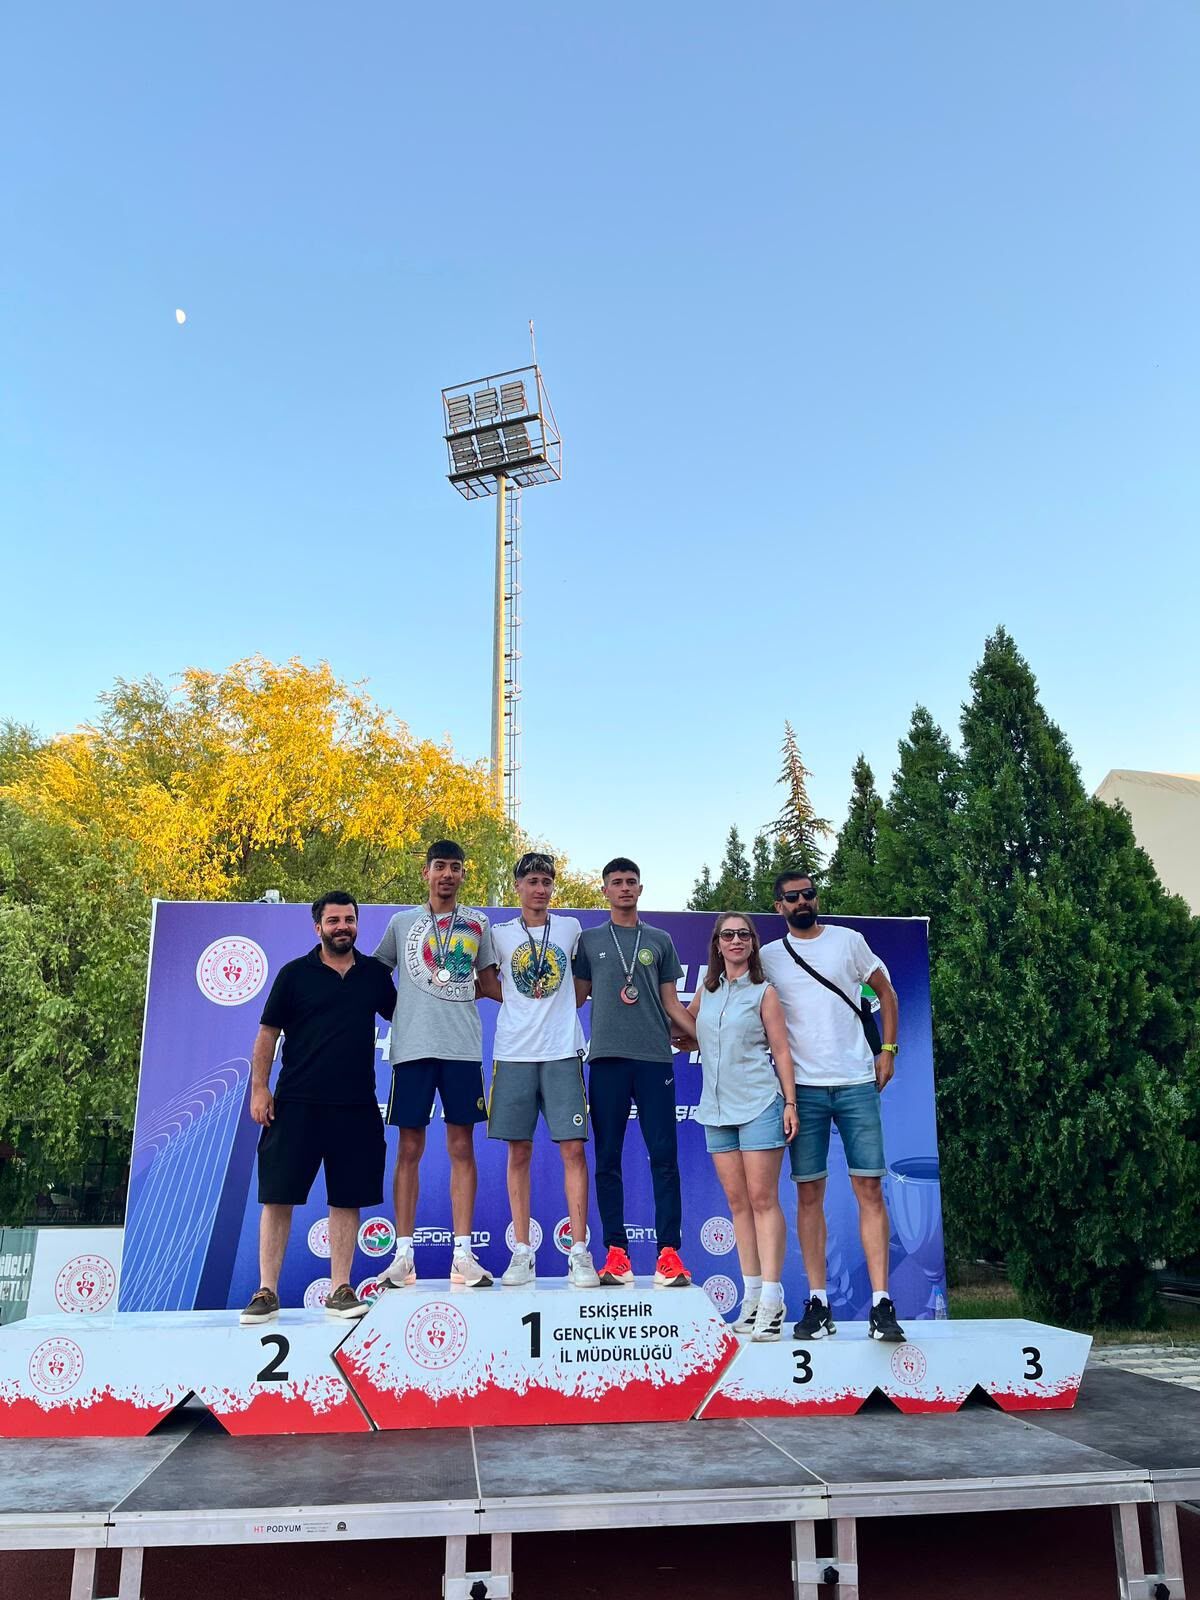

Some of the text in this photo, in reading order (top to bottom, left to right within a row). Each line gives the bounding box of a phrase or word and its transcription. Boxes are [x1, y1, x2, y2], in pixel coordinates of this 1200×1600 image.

[579, 1301, 653, 1321] ESKİŞEHİR
[521, 1311, 541, 1358] 1
[553, 1324, 679, 1344] GENÇLİK VE SPOR
[256, 1334, 289, 1381] 2
[560, 1344, 672, 1363] İL MÜDÜRLÜĞÜ
[792, 1350, 814, 1384] 3
[1022, 1346, 1043, 1380] 3
[253, 1525, 265, 1534] HT
[266, 1525, 302, 1533] PODYUM
